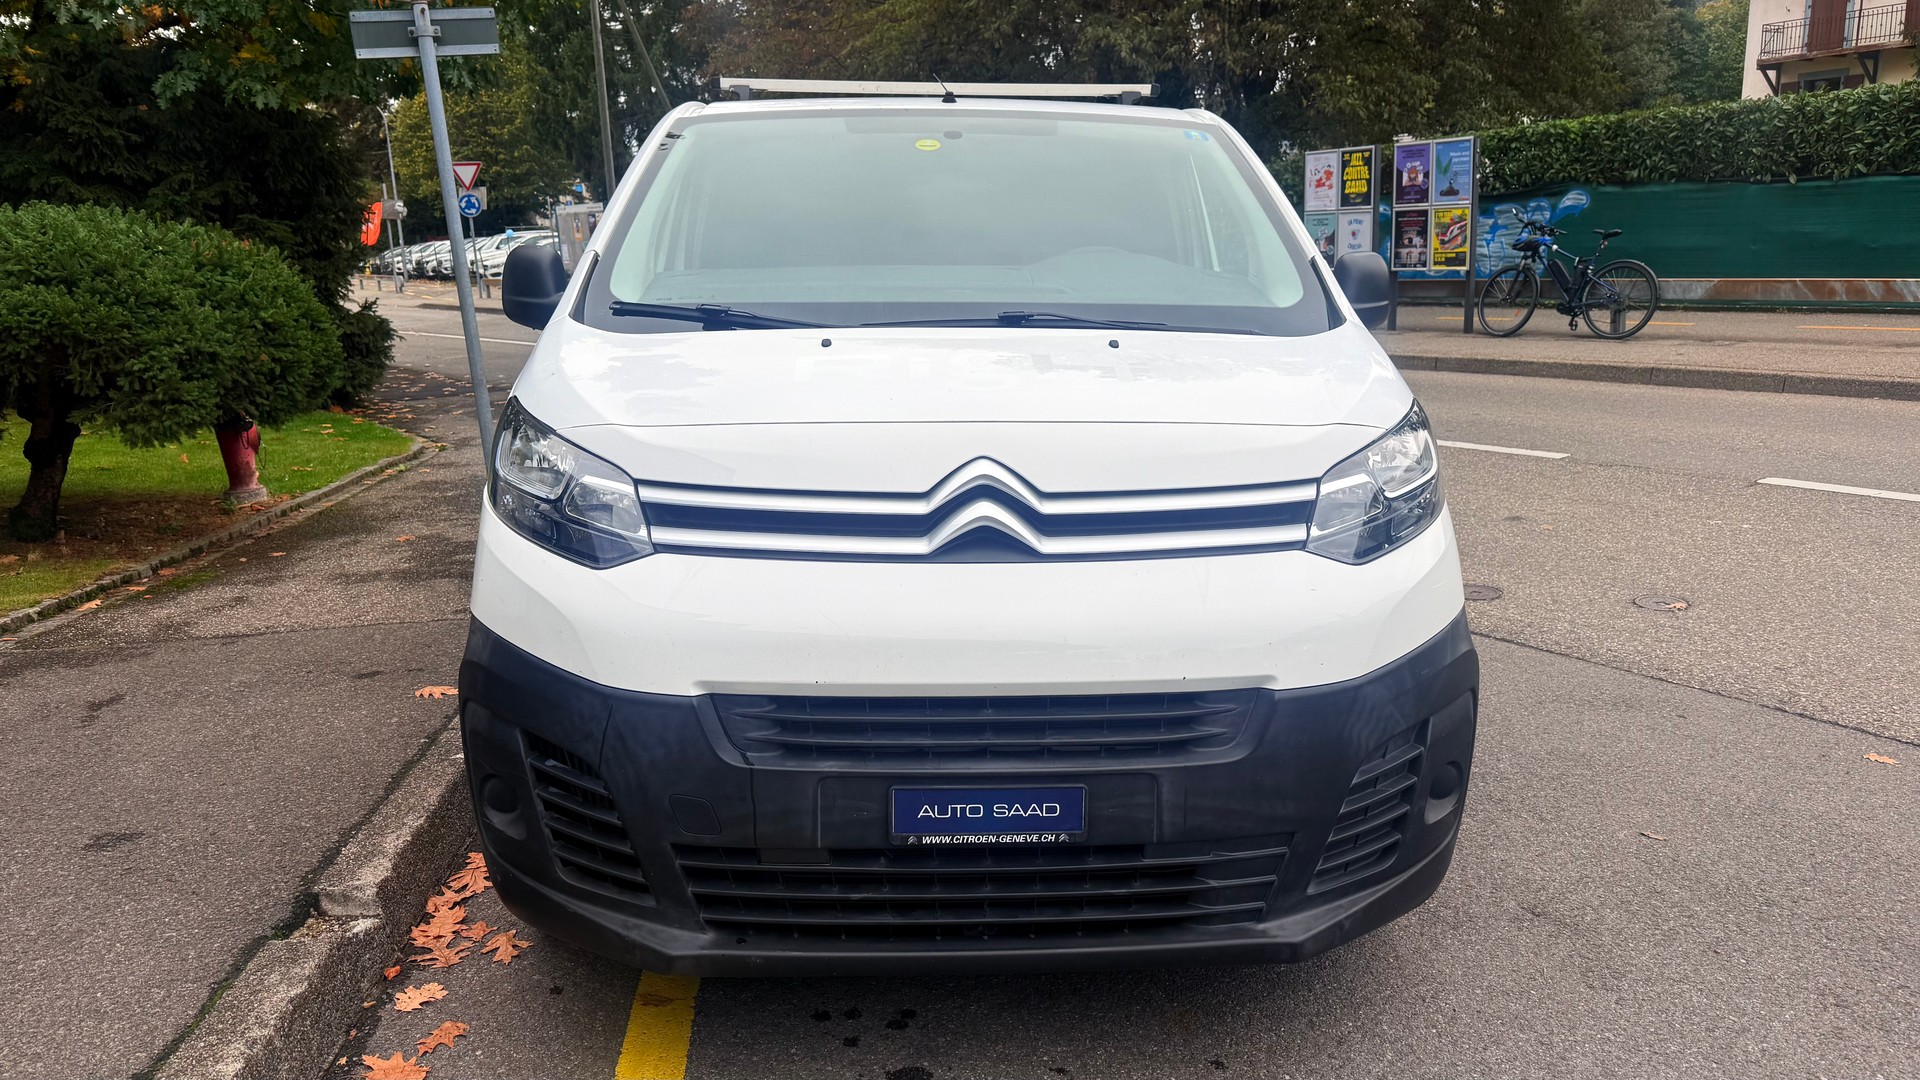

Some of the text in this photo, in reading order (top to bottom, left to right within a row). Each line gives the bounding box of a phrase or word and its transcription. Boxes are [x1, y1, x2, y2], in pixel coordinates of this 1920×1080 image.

[1350, 152, 1364, 166] JAZZ
[1343, 166, 1370, 180] CONTRE
[1344, 180, 1368, 193] BAND
[917, 803, 1060, 818] AUTO SAAD
[922, 834, 1056, 844] WWW.CITROEN-GENEVE.CH
